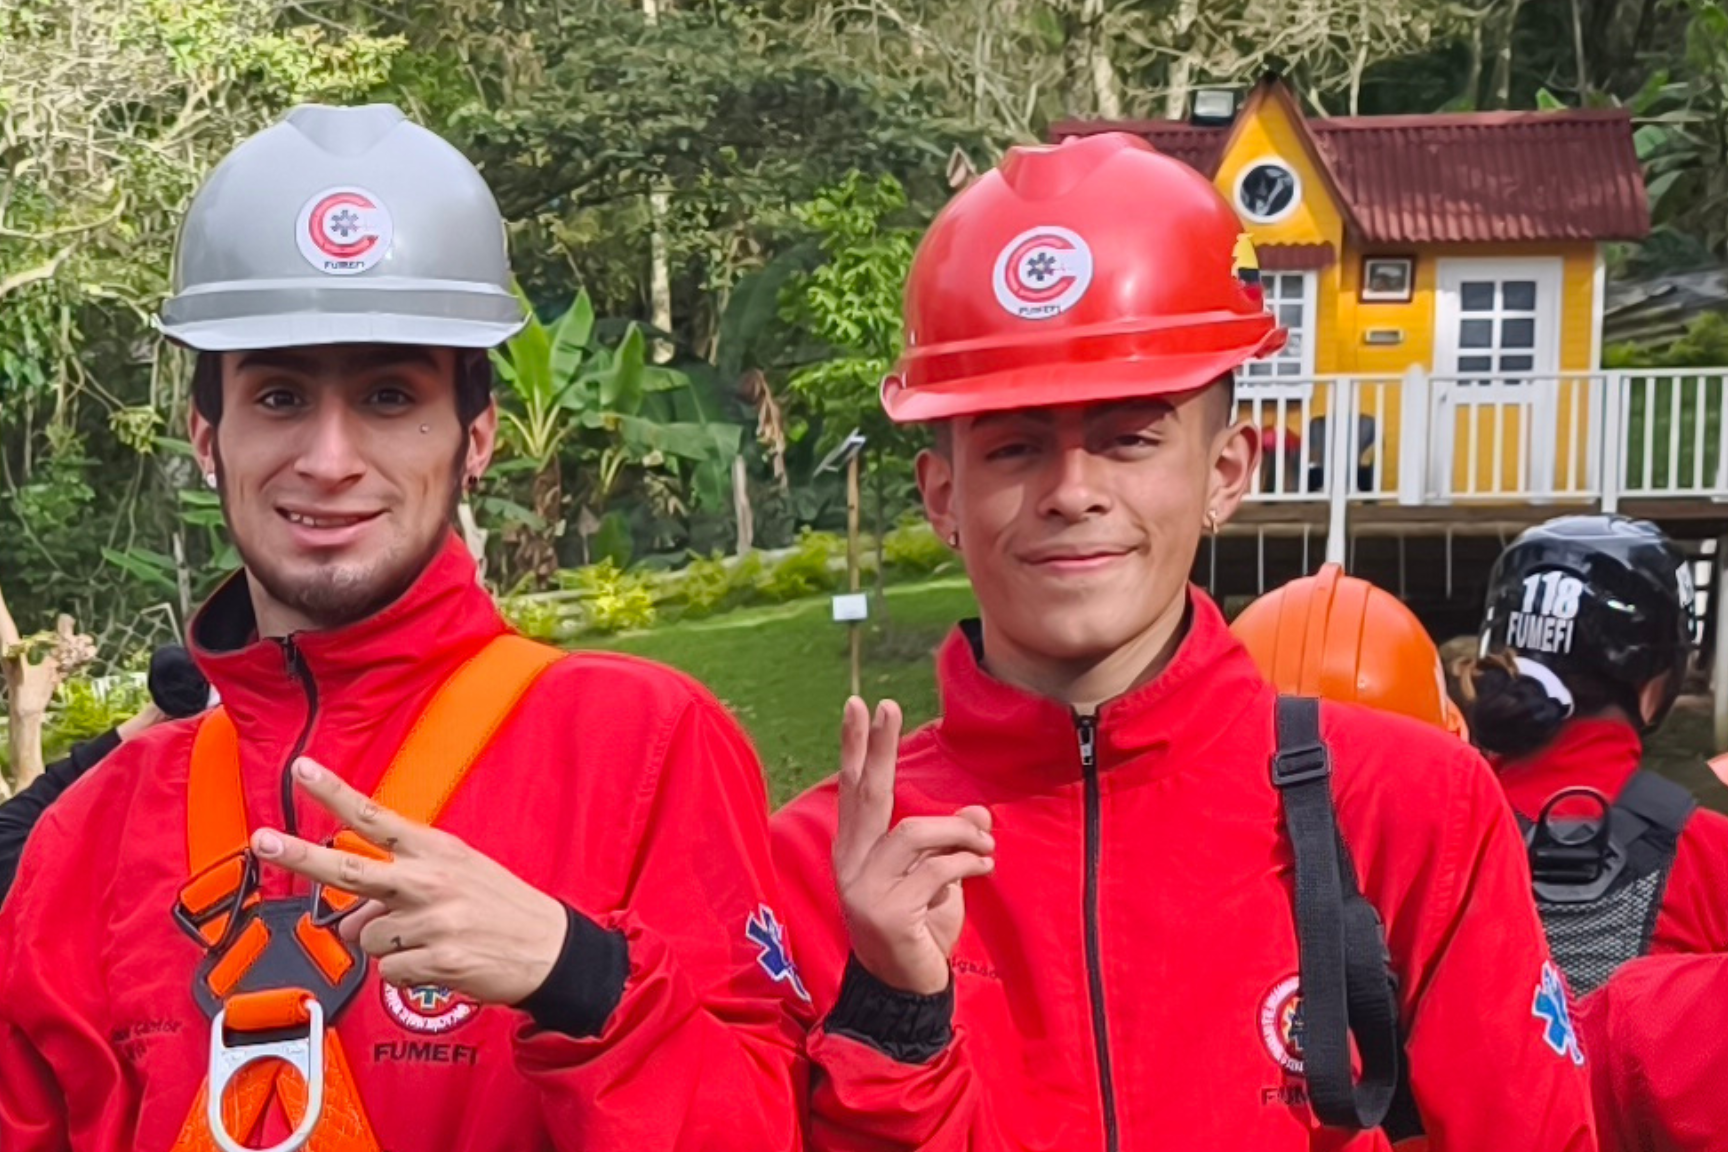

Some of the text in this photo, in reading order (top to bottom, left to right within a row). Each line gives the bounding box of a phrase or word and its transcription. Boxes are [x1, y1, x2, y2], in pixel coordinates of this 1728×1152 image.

[1523, 571, 1583, 619] 118
[1506, 611, 1575, 654] FUMEFI
[373, 1041, 479, 1065] FUMEFI
